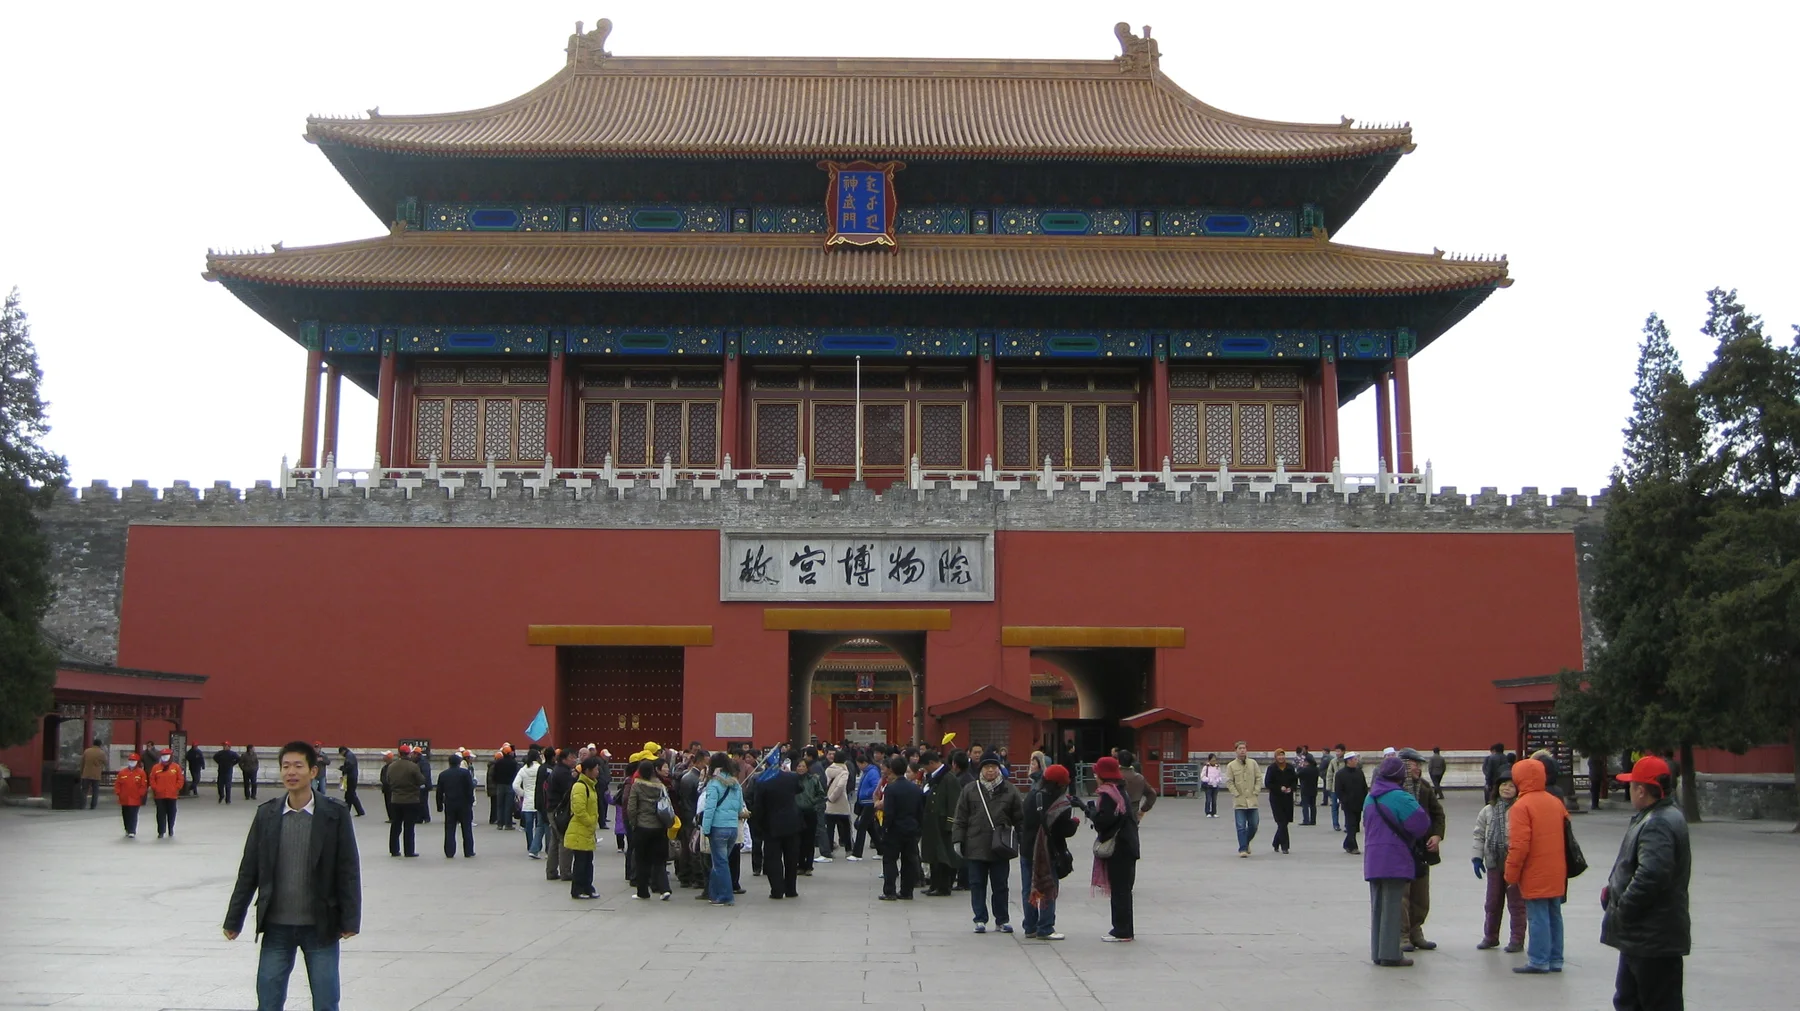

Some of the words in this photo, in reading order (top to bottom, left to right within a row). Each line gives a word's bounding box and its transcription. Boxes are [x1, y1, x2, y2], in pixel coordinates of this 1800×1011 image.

[842, 175, 858, 230] 神武門
[739, 544, 973, 587] 故宫博物院
